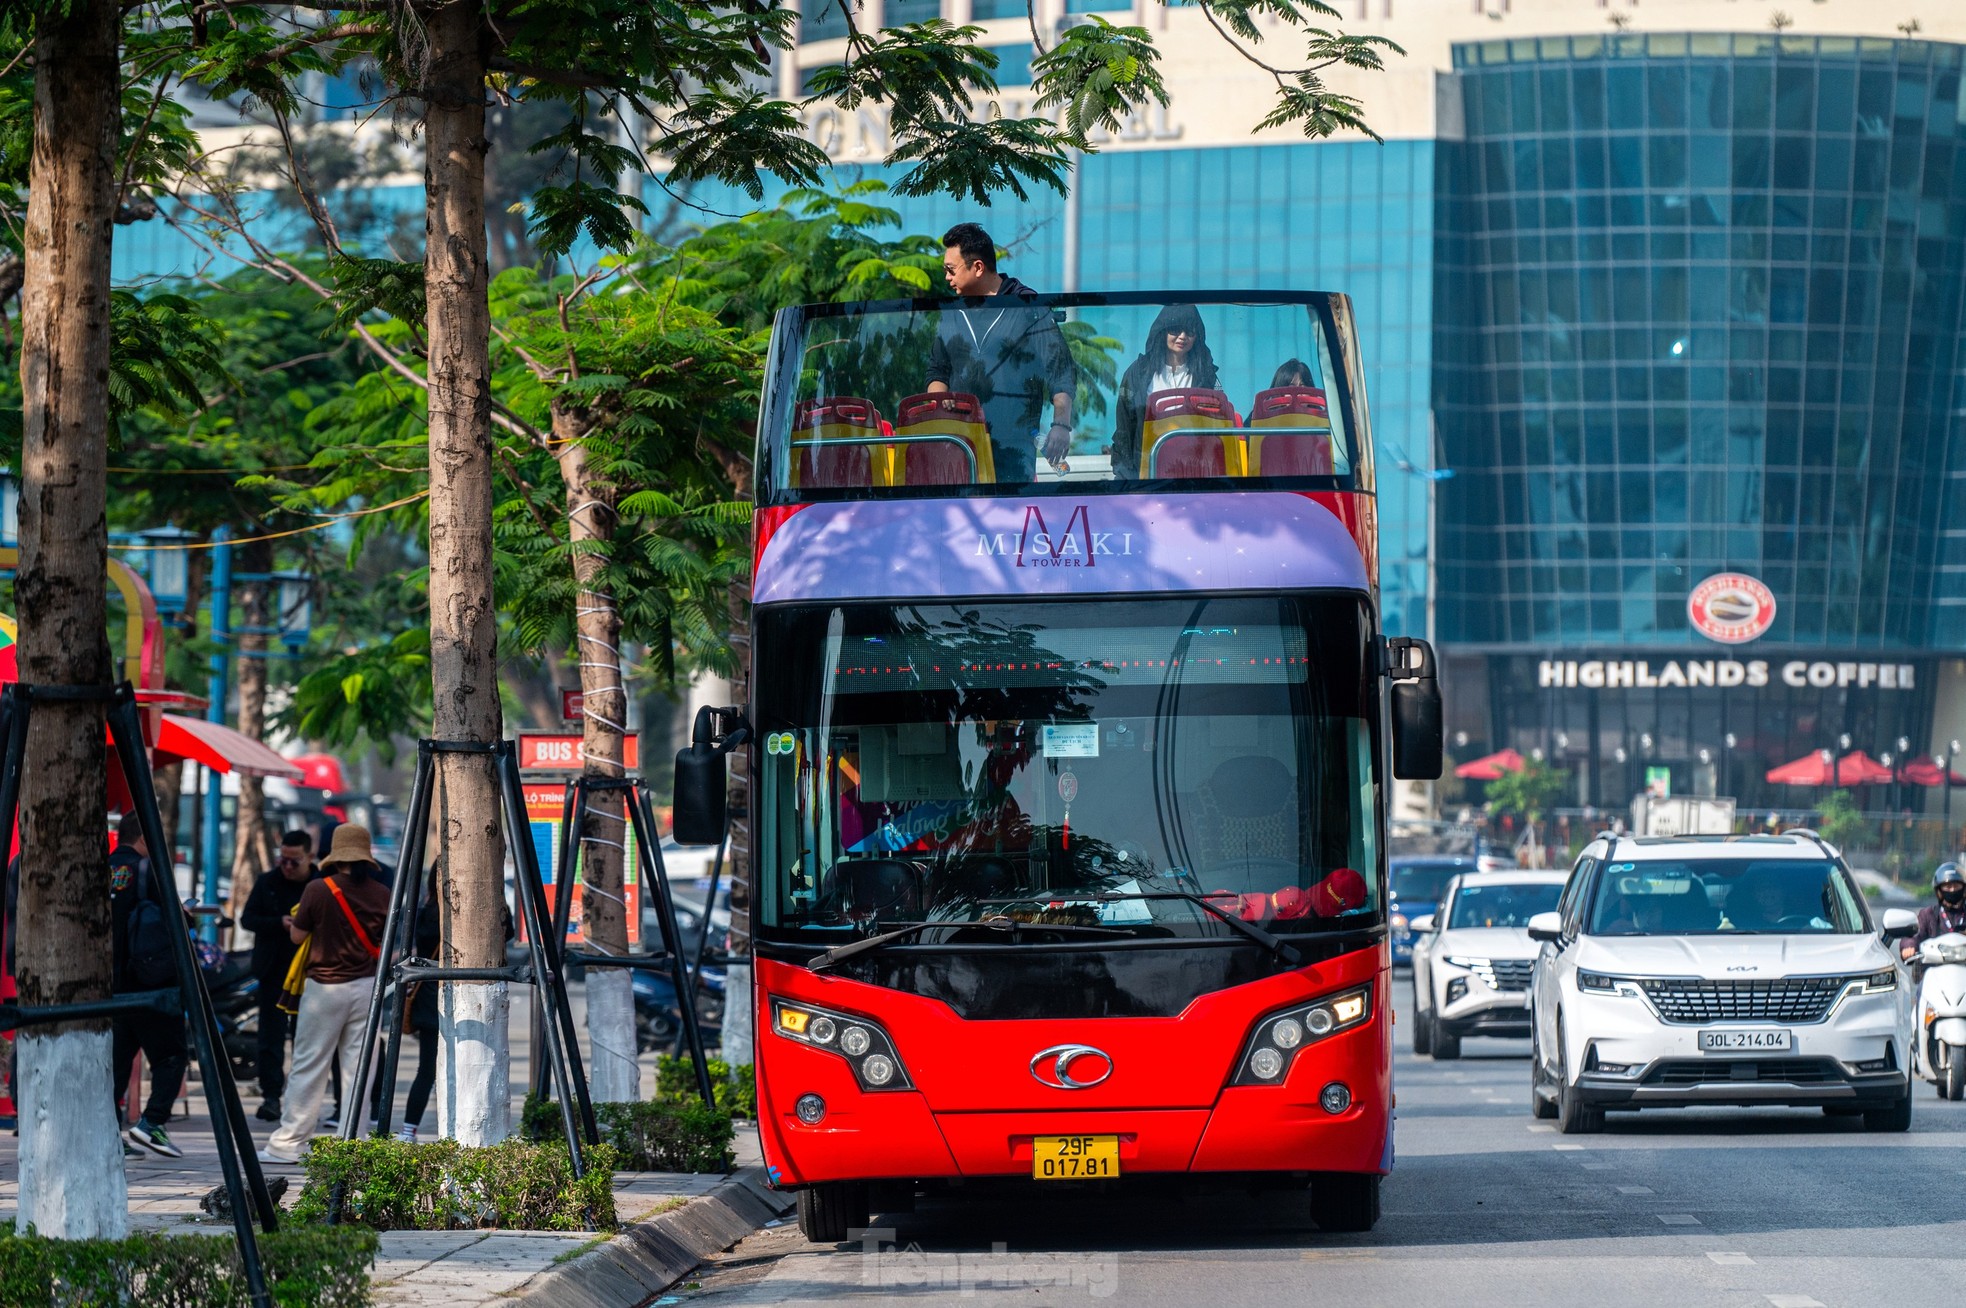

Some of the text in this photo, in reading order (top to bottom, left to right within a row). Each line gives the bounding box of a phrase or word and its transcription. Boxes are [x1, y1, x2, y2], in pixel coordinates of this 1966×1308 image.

[974, 532, 1133, 556] MISAKI
[1031, 558, 1081, 567] TOWER
[1538, 660, 1915, 689] HIGHLANDS COFFEE
[536, 741, 572, 761] BUS
[1058, 1137, 1093, 1156] 29F
[1043, 1157, 1107, 1176] 017.81
